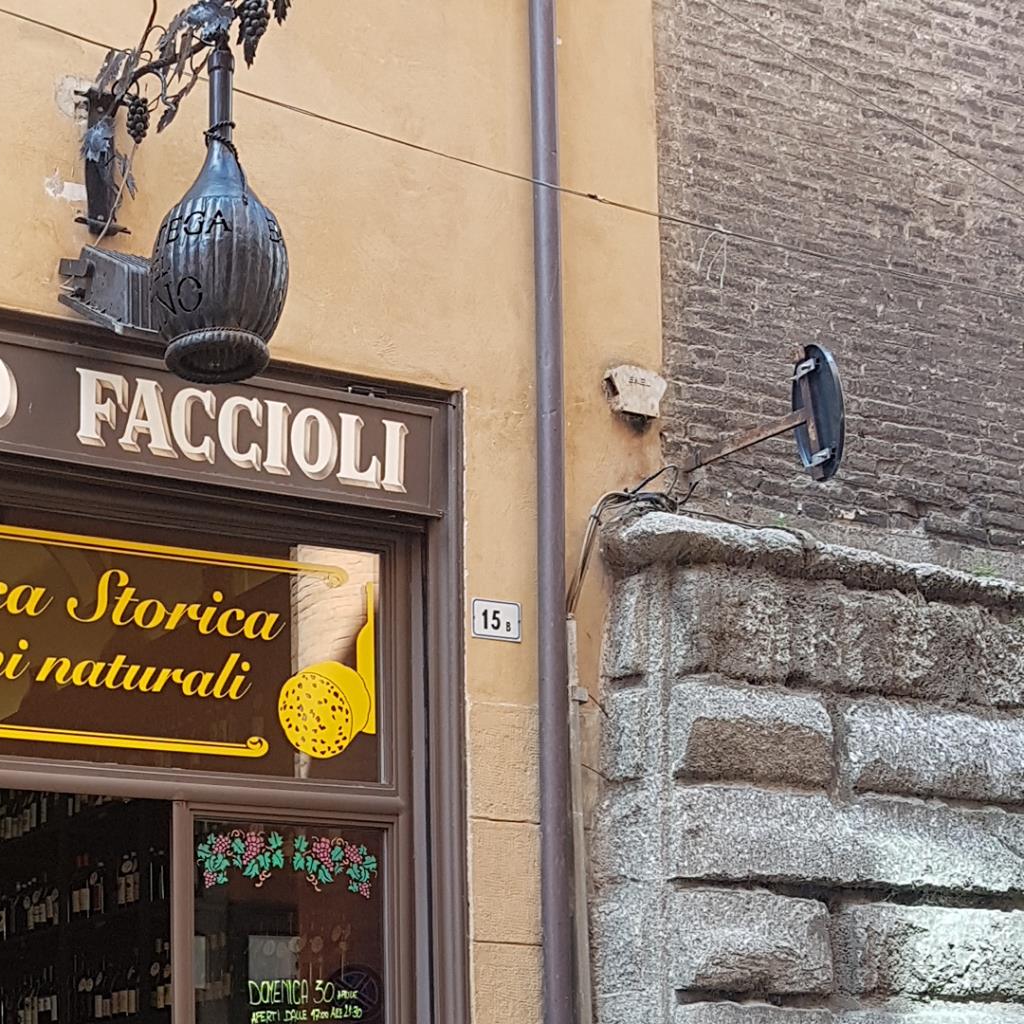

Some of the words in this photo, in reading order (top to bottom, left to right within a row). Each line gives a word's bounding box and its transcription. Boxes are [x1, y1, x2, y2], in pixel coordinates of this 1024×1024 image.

[76, 366, 410, 495] FACCIOLI
[66, 569, 287, 643] Storica
[40, 651, 254, 701] naturali
[248, 979, 309, 1005] DOMENICA
[313, 979, 335, 1004] 30
[251, 1009, 281, 1024] APERTI
[283, 1009, 308, 1022] DALLE
